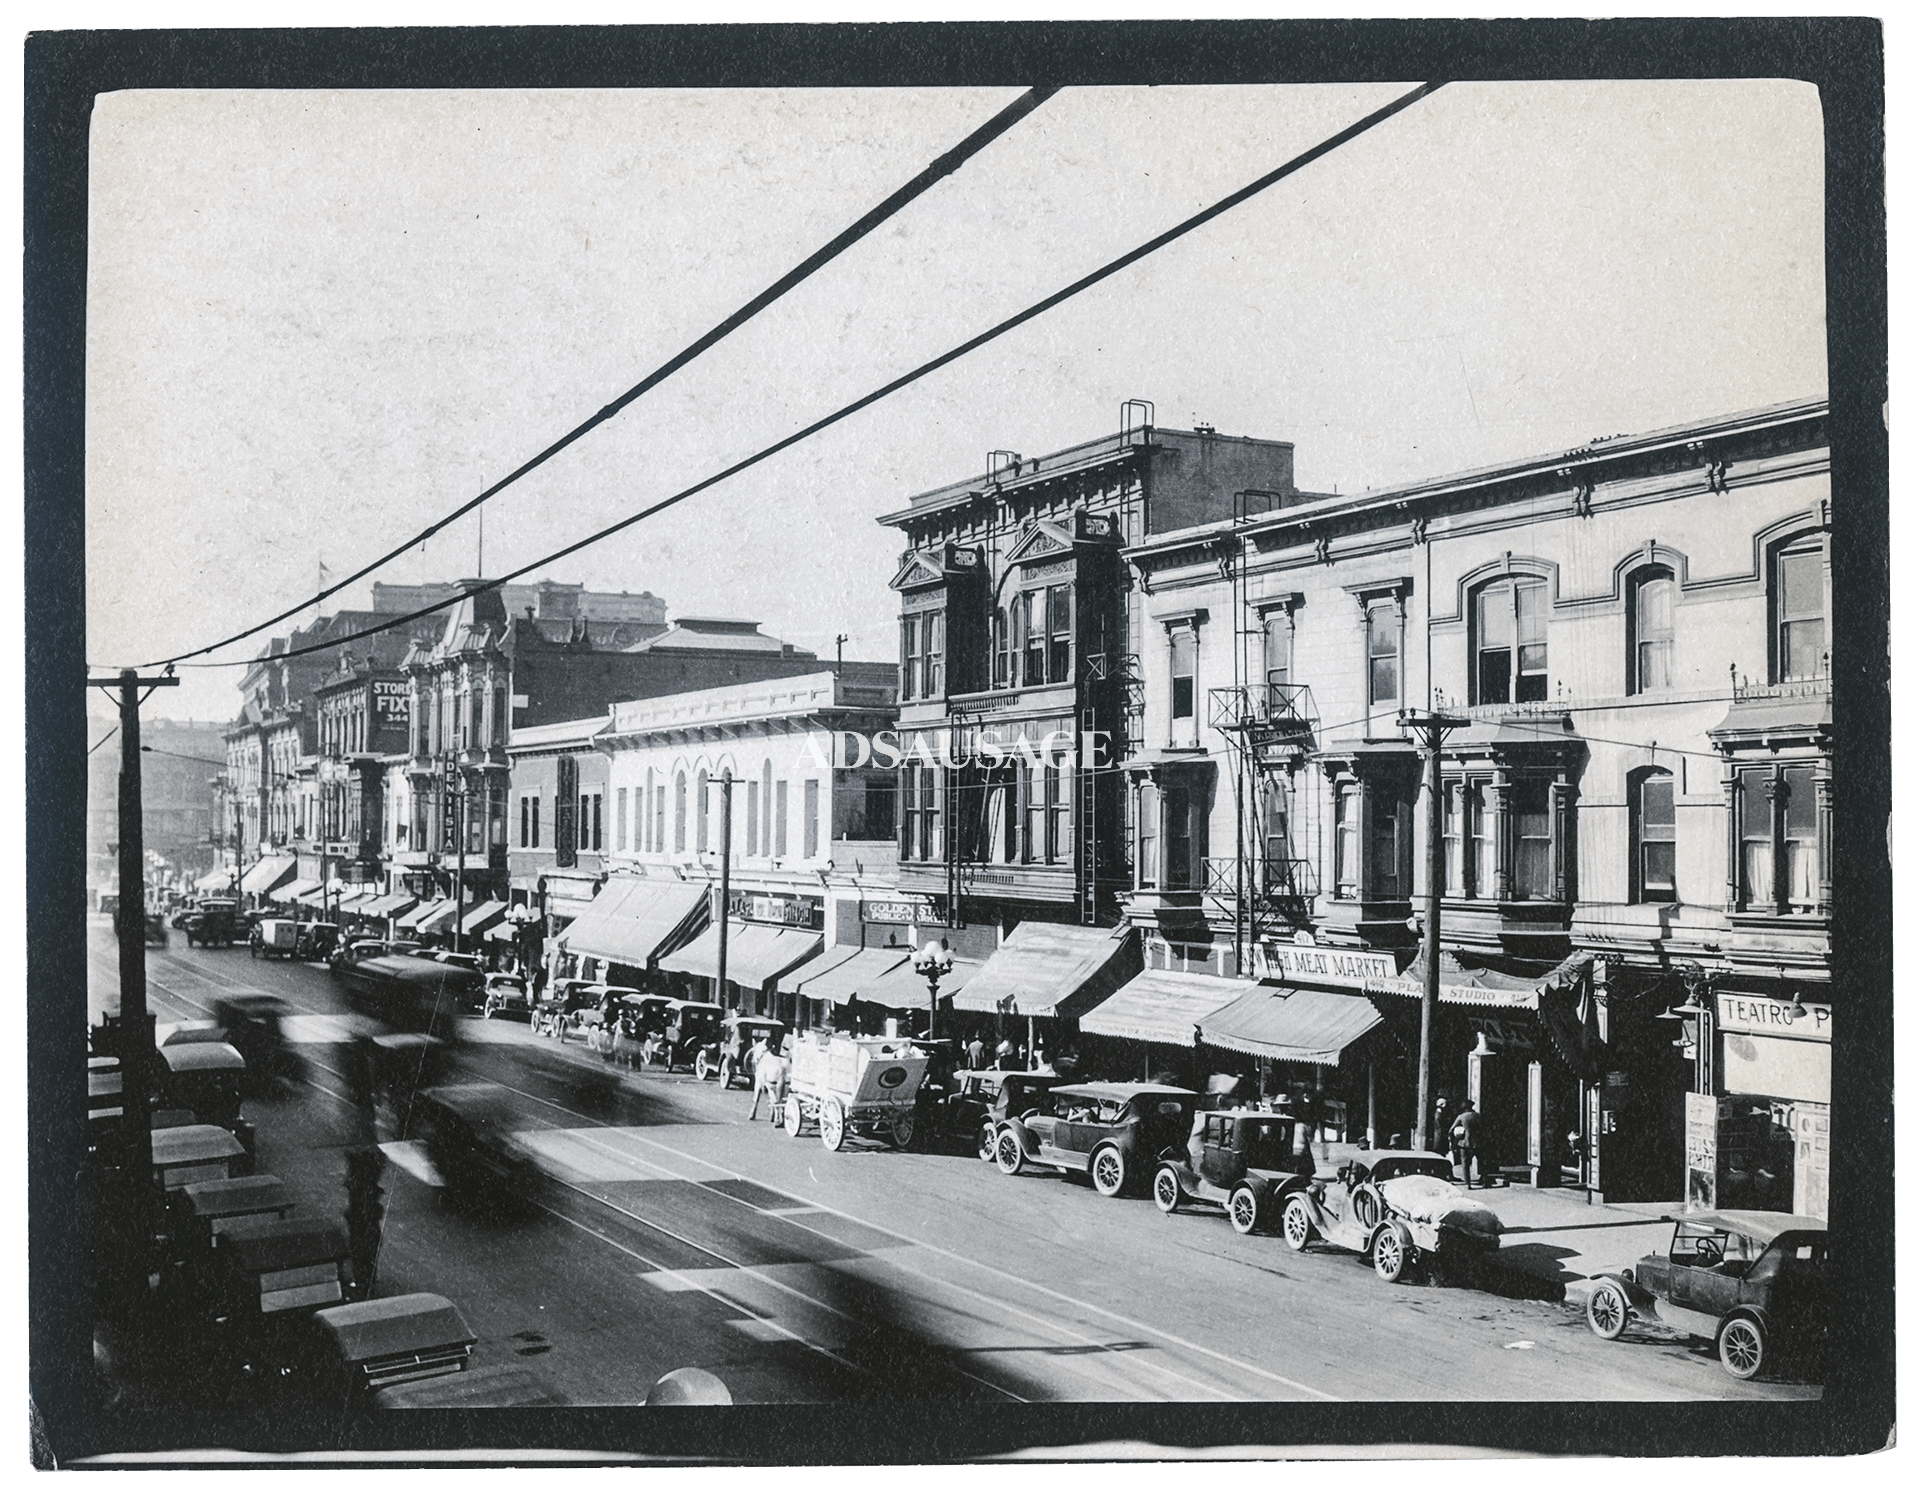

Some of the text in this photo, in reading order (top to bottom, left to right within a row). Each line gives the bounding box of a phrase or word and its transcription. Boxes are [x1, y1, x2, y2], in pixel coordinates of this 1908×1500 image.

[869, 902, 914, 915] GOLDEN
[872, 911, 902, 922] PUBLIC
[1294, 952, 1328, 974] MEAT
[1332, 955, 1388, 978] MARKET
[1449, 989, 1495, 1001] STUDIO
